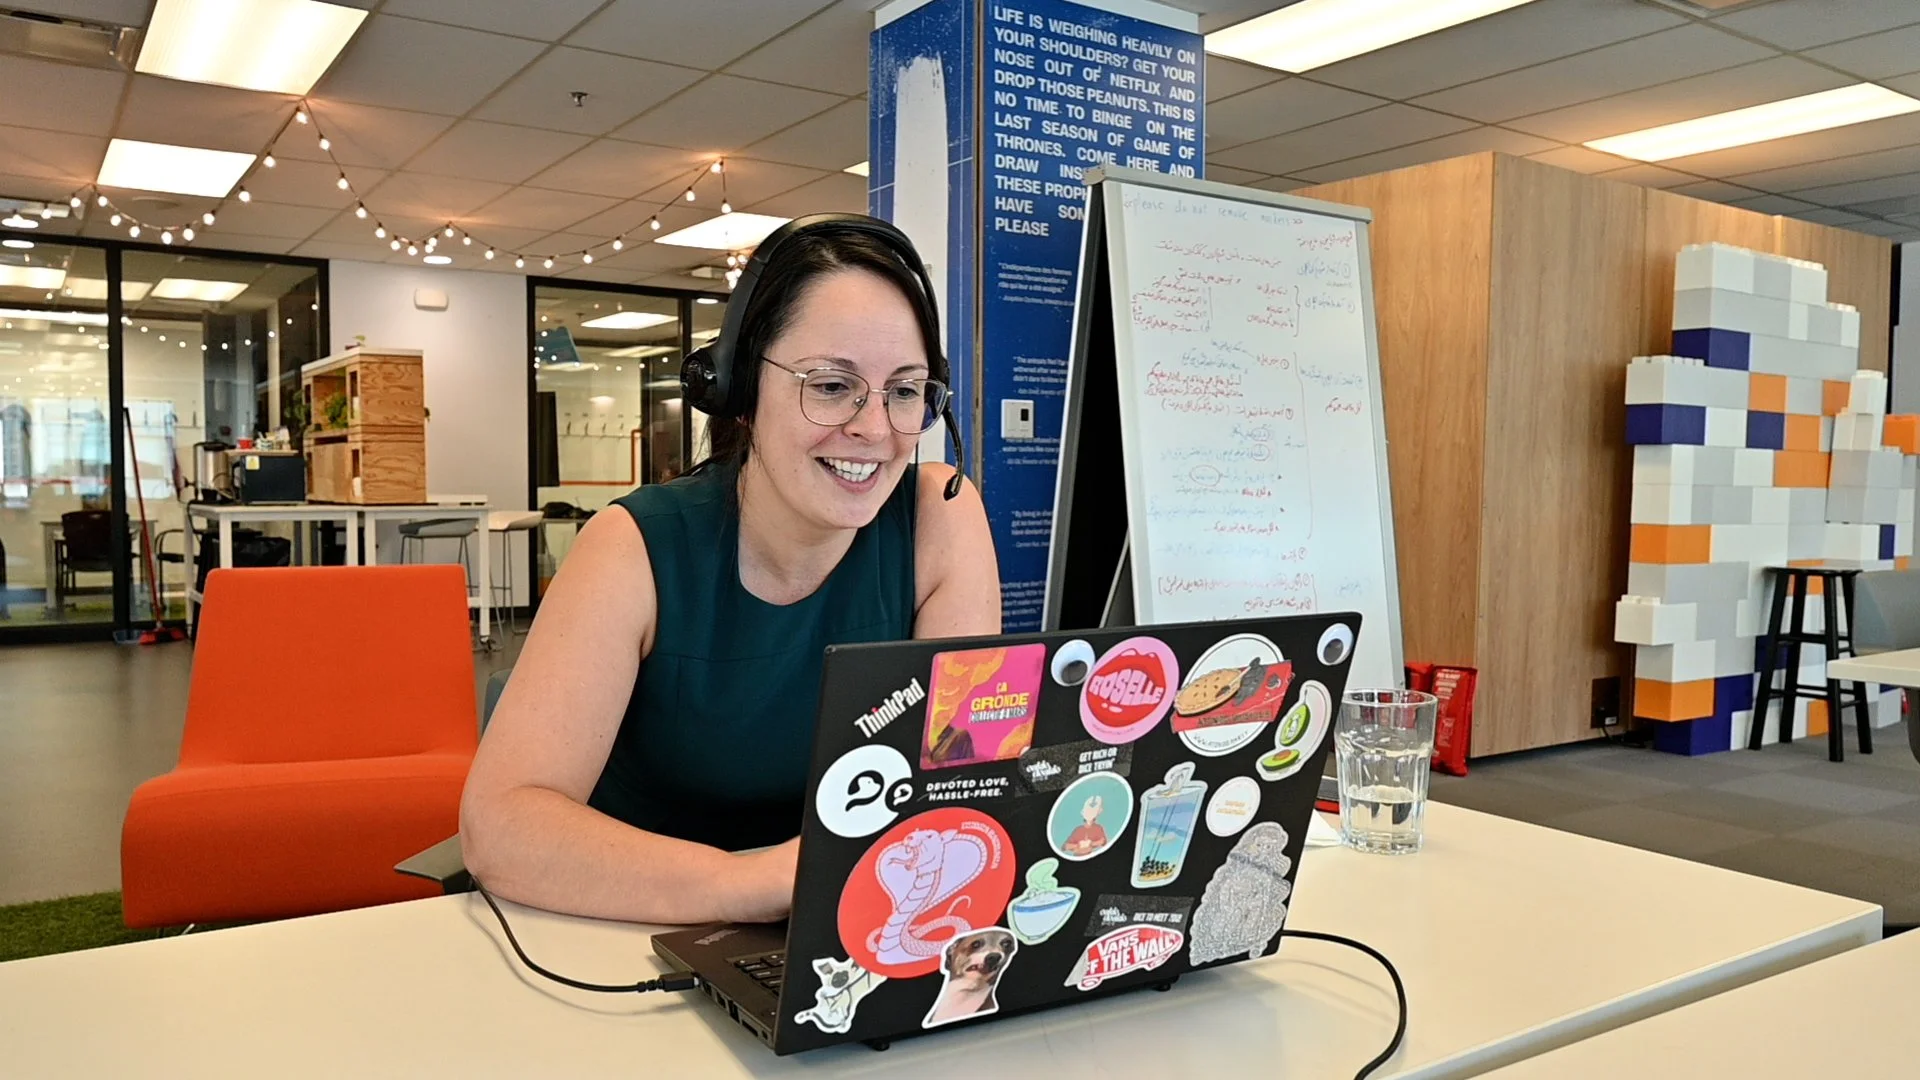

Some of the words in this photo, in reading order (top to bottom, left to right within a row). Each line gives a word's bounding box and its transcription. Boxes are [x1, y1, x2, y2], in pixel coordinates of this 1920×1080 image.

[995, 6, 1023, 26] LIFE
[1029, 14, 1043, 29] IS
[1049, 18, 1117, 46] WEIGHING
[1122, 35, 1173, 58] HEAVILY
[1177, 50, 1195, 65] ON
[995, 28, 1035, 49] YOUR
[1040, 38, 1129, 69] SHOULDERS?
[1133, 59, 1157, 75] GET
[1162, 65, 1195, 84] YOUR
[995, 49, 1035, 69] NOSE
[1044, 59, 1073, 77] OUT
[1083, 67, 1102, 82] OF
[1110, 73, 1161, 95] NETFLIX
[1169, 87, 1195, 102] AND
[995, 70, 1035, 90] DROP
[1038, 78, 1084, 100] THOSE
[1087, 90, 1150, 113] PEANUTS.
[1153, 102, 1180, 119] THIS
[1183, 108, 1195, 122] IS
[995, 91, 1016, 107] NO
[1025, 96, 1059, 115] TIME
[1066, 104, 1085, 119] TO
[1092, 112, 1132, 129] BINGE
[1146, 120, 1165, 135] ON
[1172, 125, 1195, 141] THE
[995, 112, 1031, 131] LAST
[1042, 120, 1098, 142] SEASON
[1107, 132, 1125, 147] OF
[1134, 137, 1170, 156] GAME
[1179, 145, 1195, 160] OF
[995, 133, 1066, 158] THRONES.
[1077, 147, 1116, 165] COME
[1127, 155, 1159, 173] HERE
[1169, 163, 1195, 179] AND
[995, 154, 1039, 174] DRAW
[1060, 164, 1084, 181] INS
[995, 175, 1041, 194] THESE
[995, 196, 1033, 215] HAVE
[995, 217, 1049, 237] PLEASE
[971, 692, 1030, 712] GRONDE
[1088, 668, 1165, 706] ROSELLE
[854, 677, 926, 739] ThinkPad
[926, 779, 977, 792] DEVOTED
[979, 777, 1009, 787] LOVE,
[928, 787, 1003, 801] HASSLE-FREE.
[1097, 928, 1140, 955] VANS
[1100, 946, 1132, 973] THE
